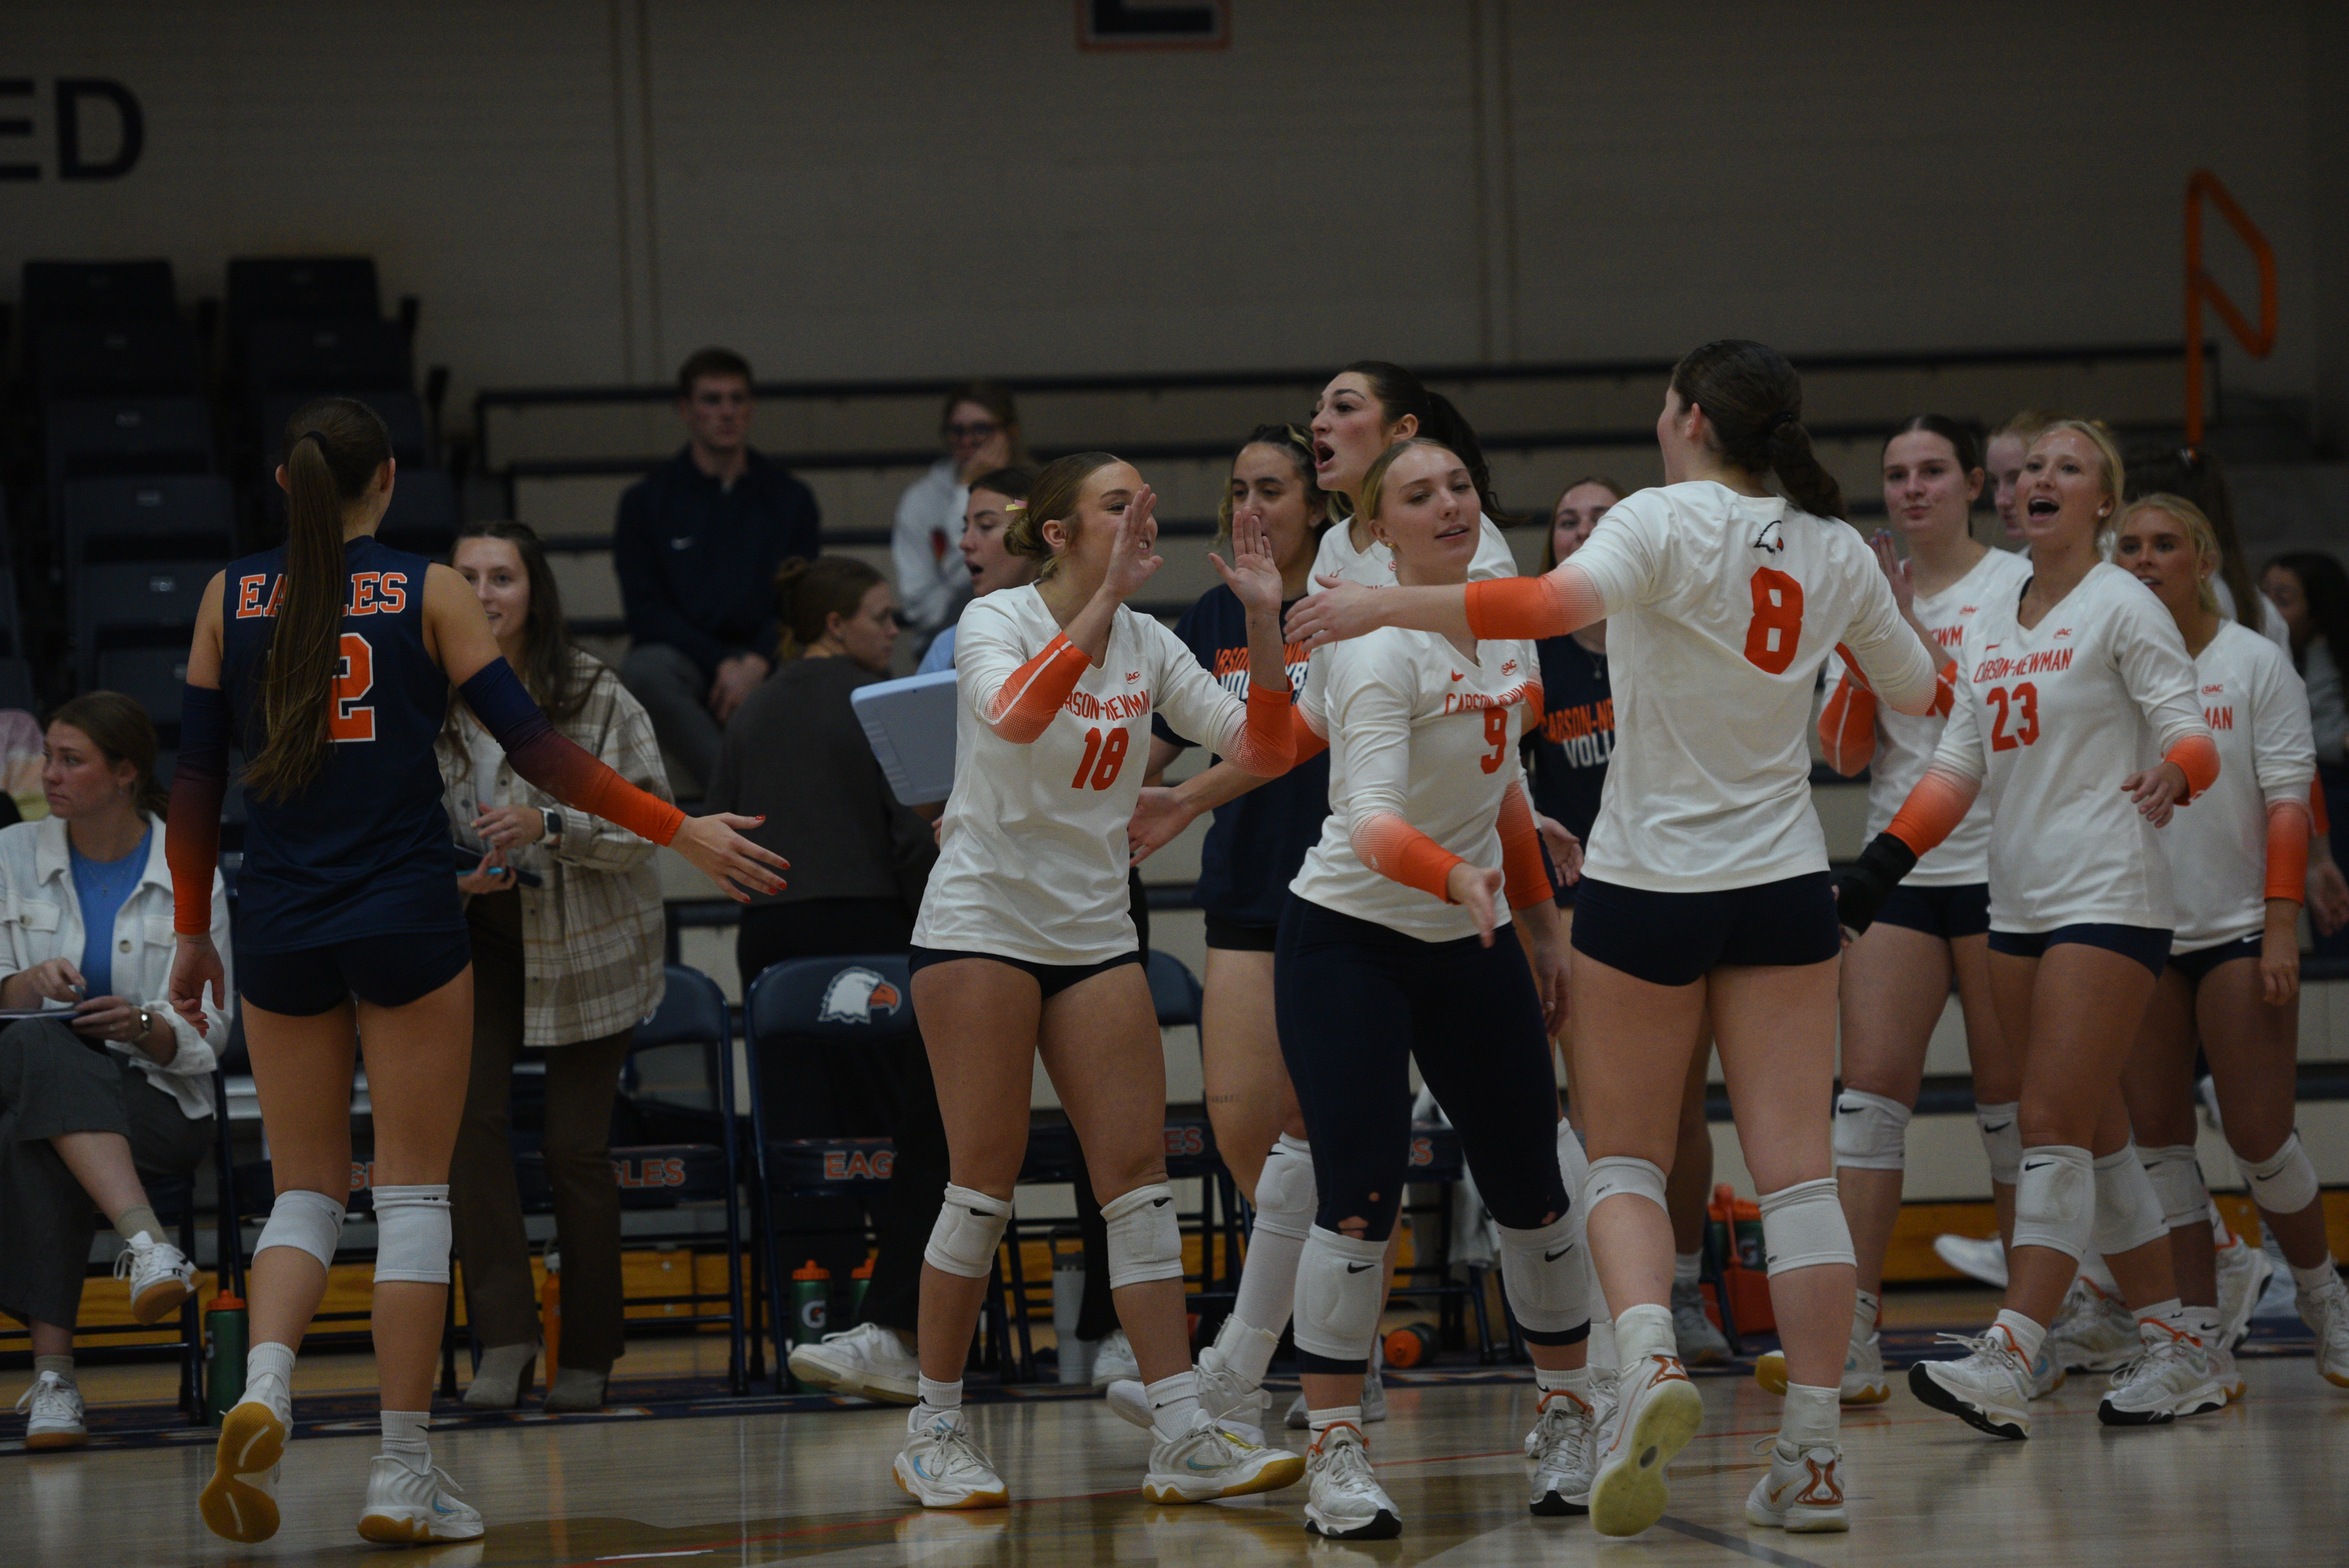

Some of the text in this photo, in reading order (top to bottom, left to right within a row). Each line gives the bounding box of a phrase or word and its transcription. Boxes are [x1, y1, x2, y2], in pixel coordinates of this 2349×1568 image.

[236, 571, 408, 619] EAES
[1744, 566, 1804, 675] 8
[323, 632, 377, 743] 2
[1987, 682, 2040, 752] 23
[1071, 727, 1129, 791] 18
[1481, 707, 1508, 774] 9
